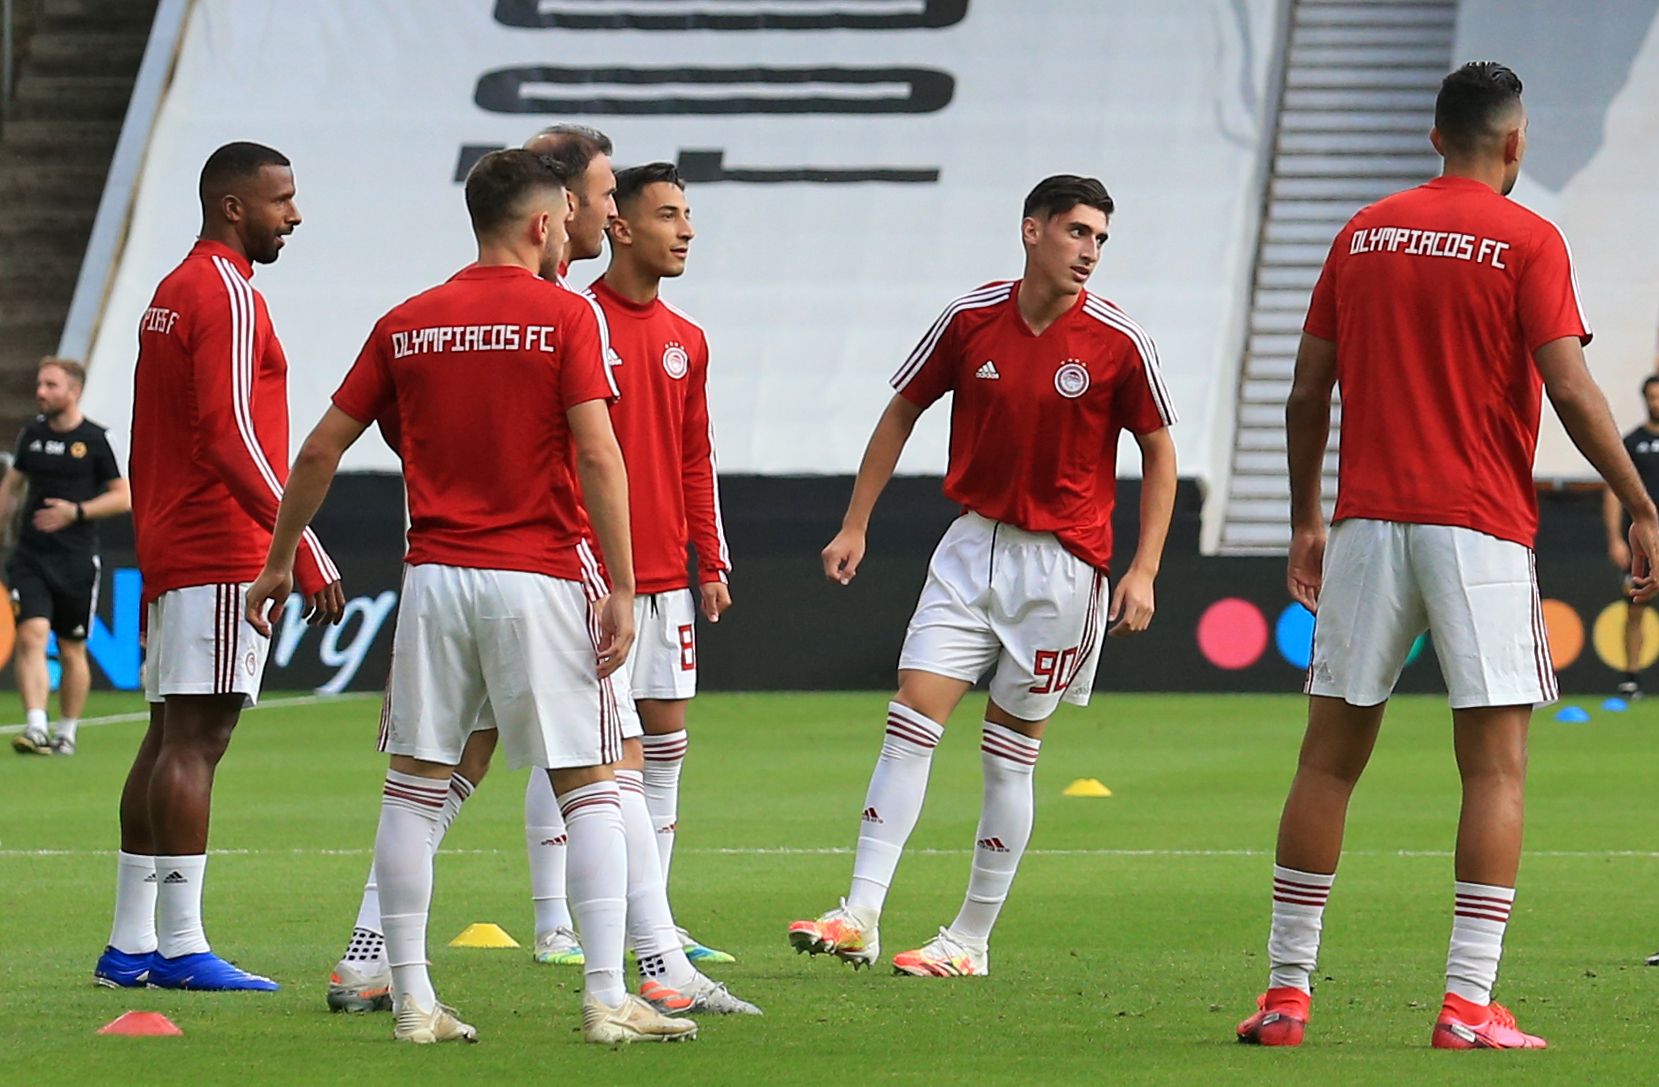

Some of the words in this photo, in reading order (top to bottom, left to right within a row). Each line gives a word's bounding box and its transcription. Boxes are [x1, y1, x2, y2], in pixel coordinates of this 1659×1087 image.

[1350, 227, 1476, 261] OLYMPIACOS
[1476, 238, 1510, 270] FC
[391, 324, 520, 359] OLYMPIACOS
[525, 325, 555, 353] FC
[1029, 646, 1079, 695] 90
